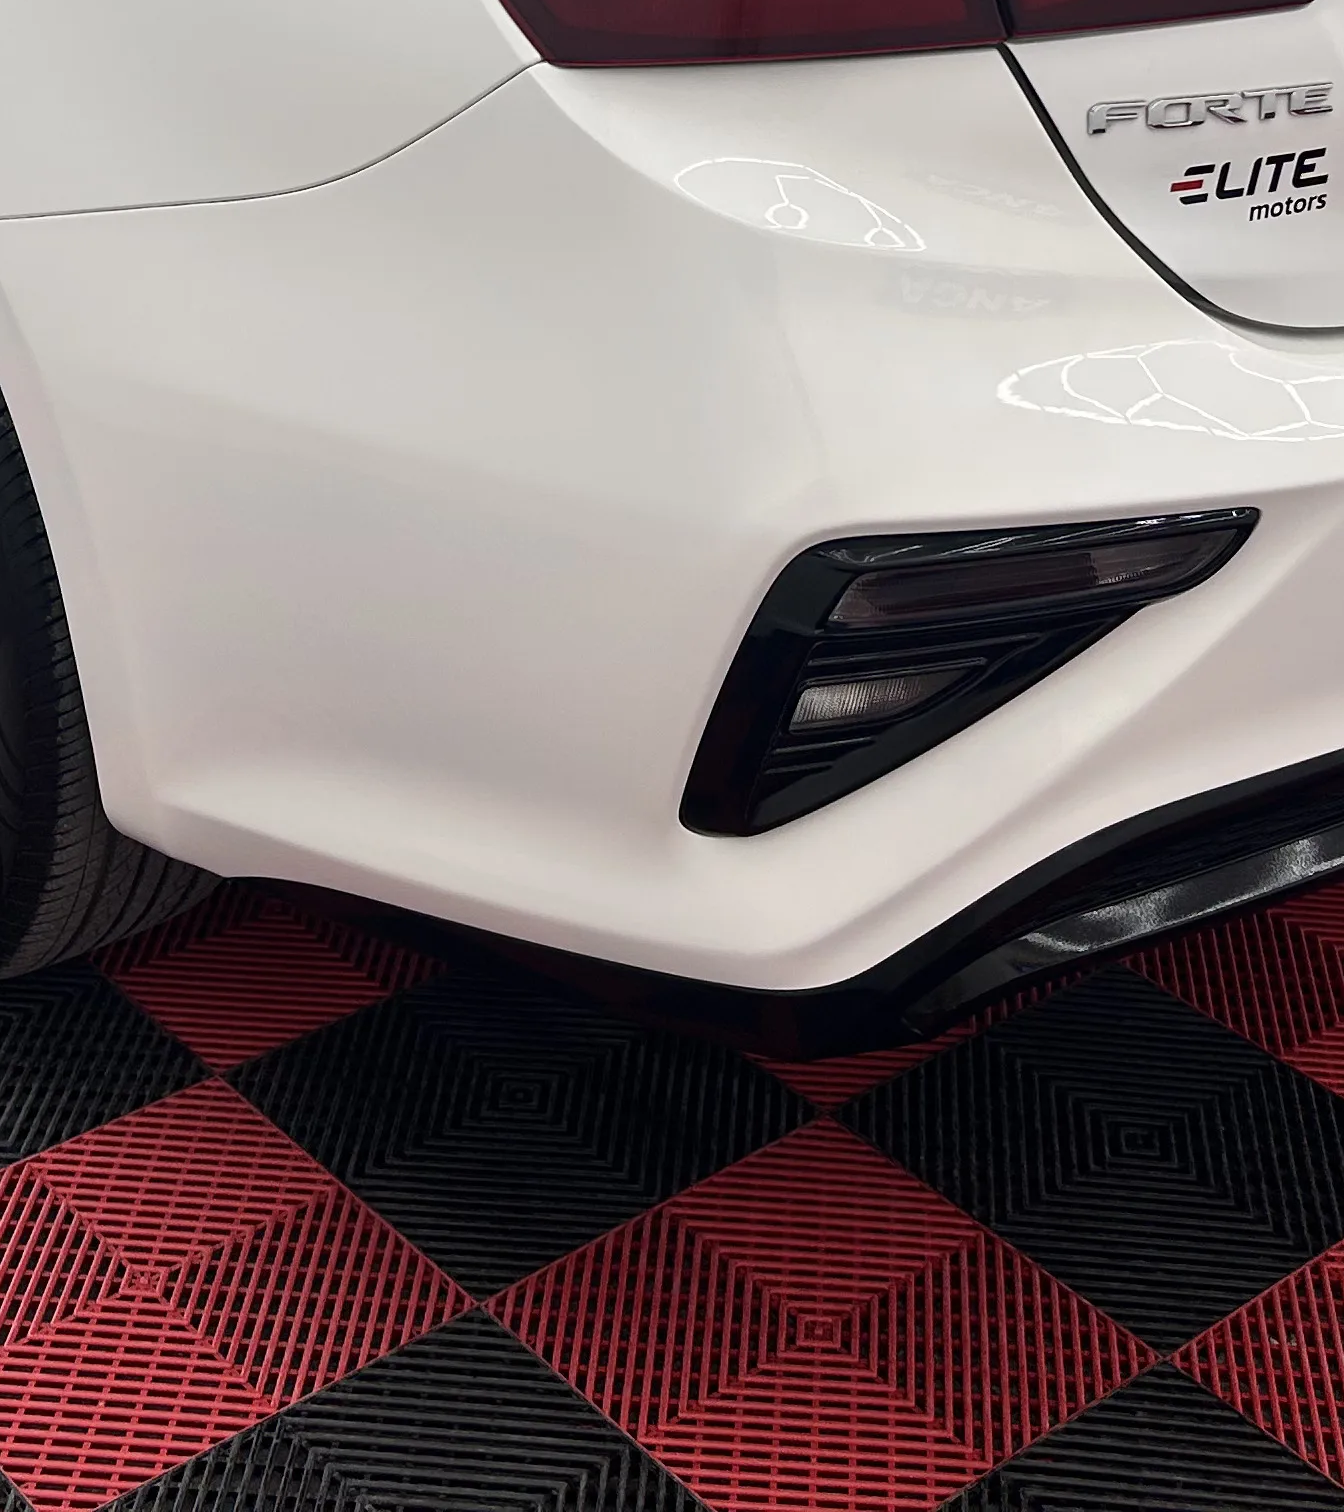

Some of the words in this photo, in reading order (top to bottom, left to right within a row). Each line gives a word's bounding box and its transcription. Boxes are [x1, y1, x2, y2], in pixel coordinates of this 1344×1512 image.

[1086, 81, 1334, 136] FORTE
[1169, 146, 1330, 206] ELITE
[1248, 192, 1328, 222] motors
